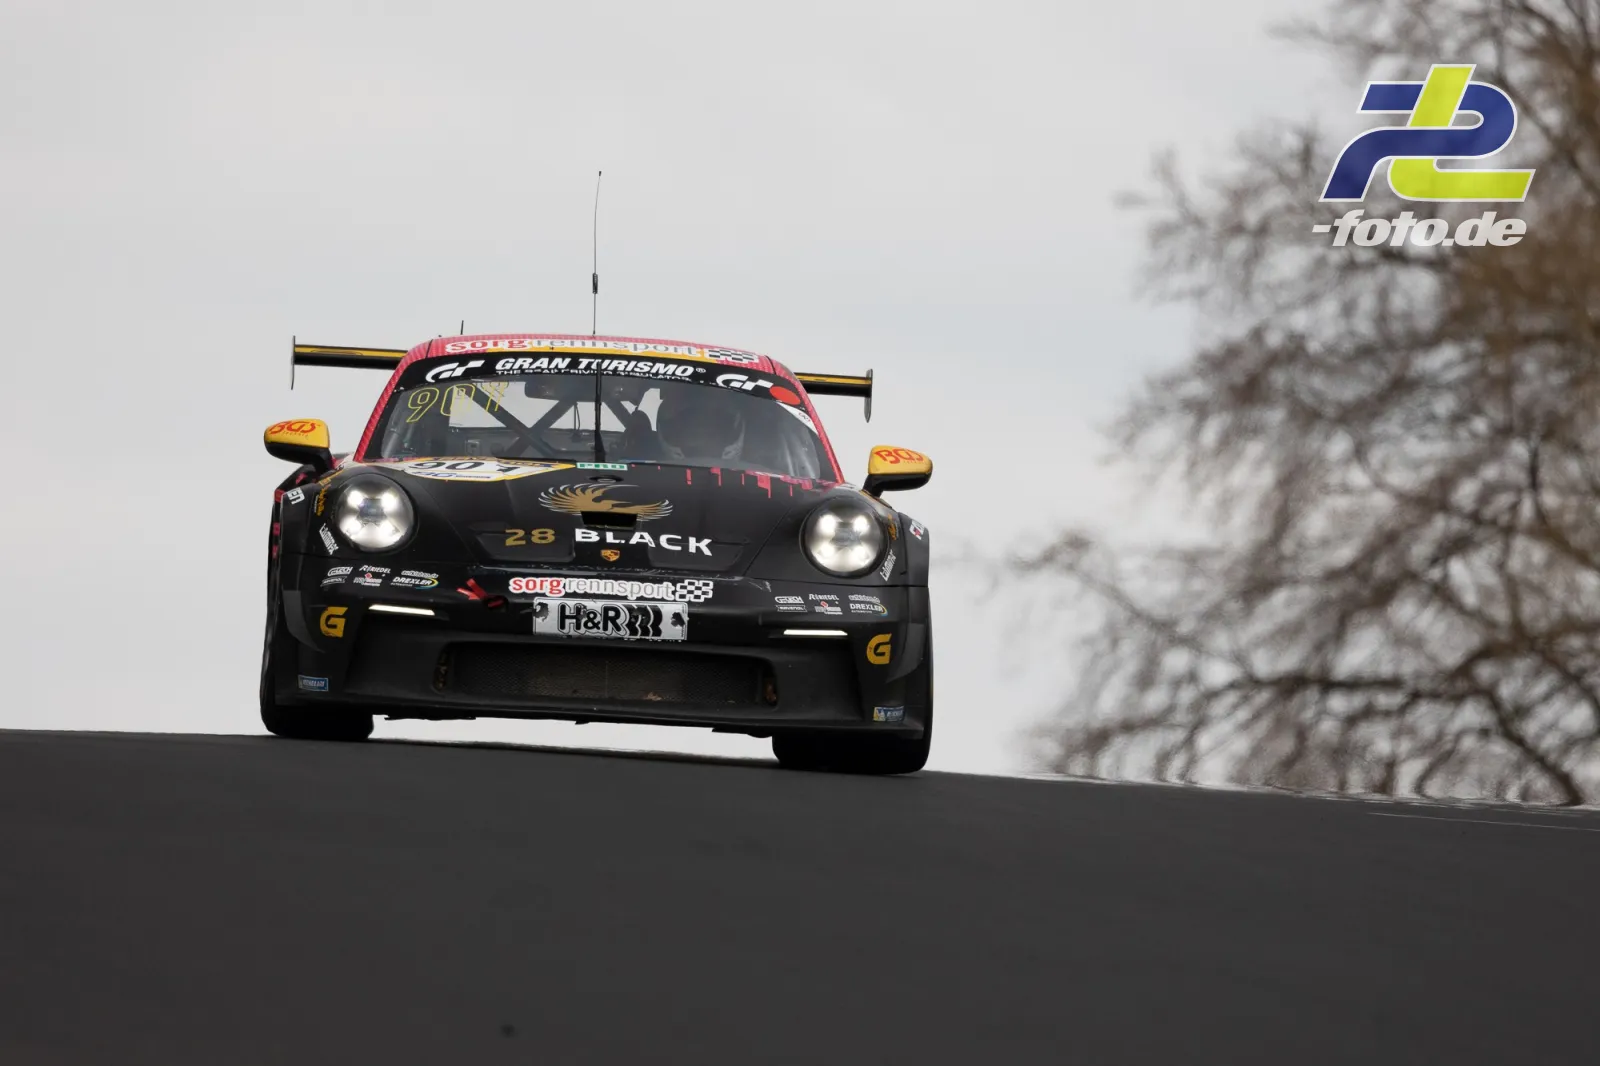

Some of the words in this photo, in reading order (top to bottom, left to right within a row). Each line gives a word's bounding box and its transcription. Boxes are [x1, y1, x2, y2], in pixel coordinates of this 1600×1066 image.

[495, 358, 571, 370] GRAN
[505, 528, 556, 547] 28
[575, 528, 713, 557] BLACK
[392, 576, 432, 586] DREXLER
[510, 577, 674, 600] sorgrennsport
[849, 603, 883, 613] DREXLER
[557, 602, 626, 636] H&R
